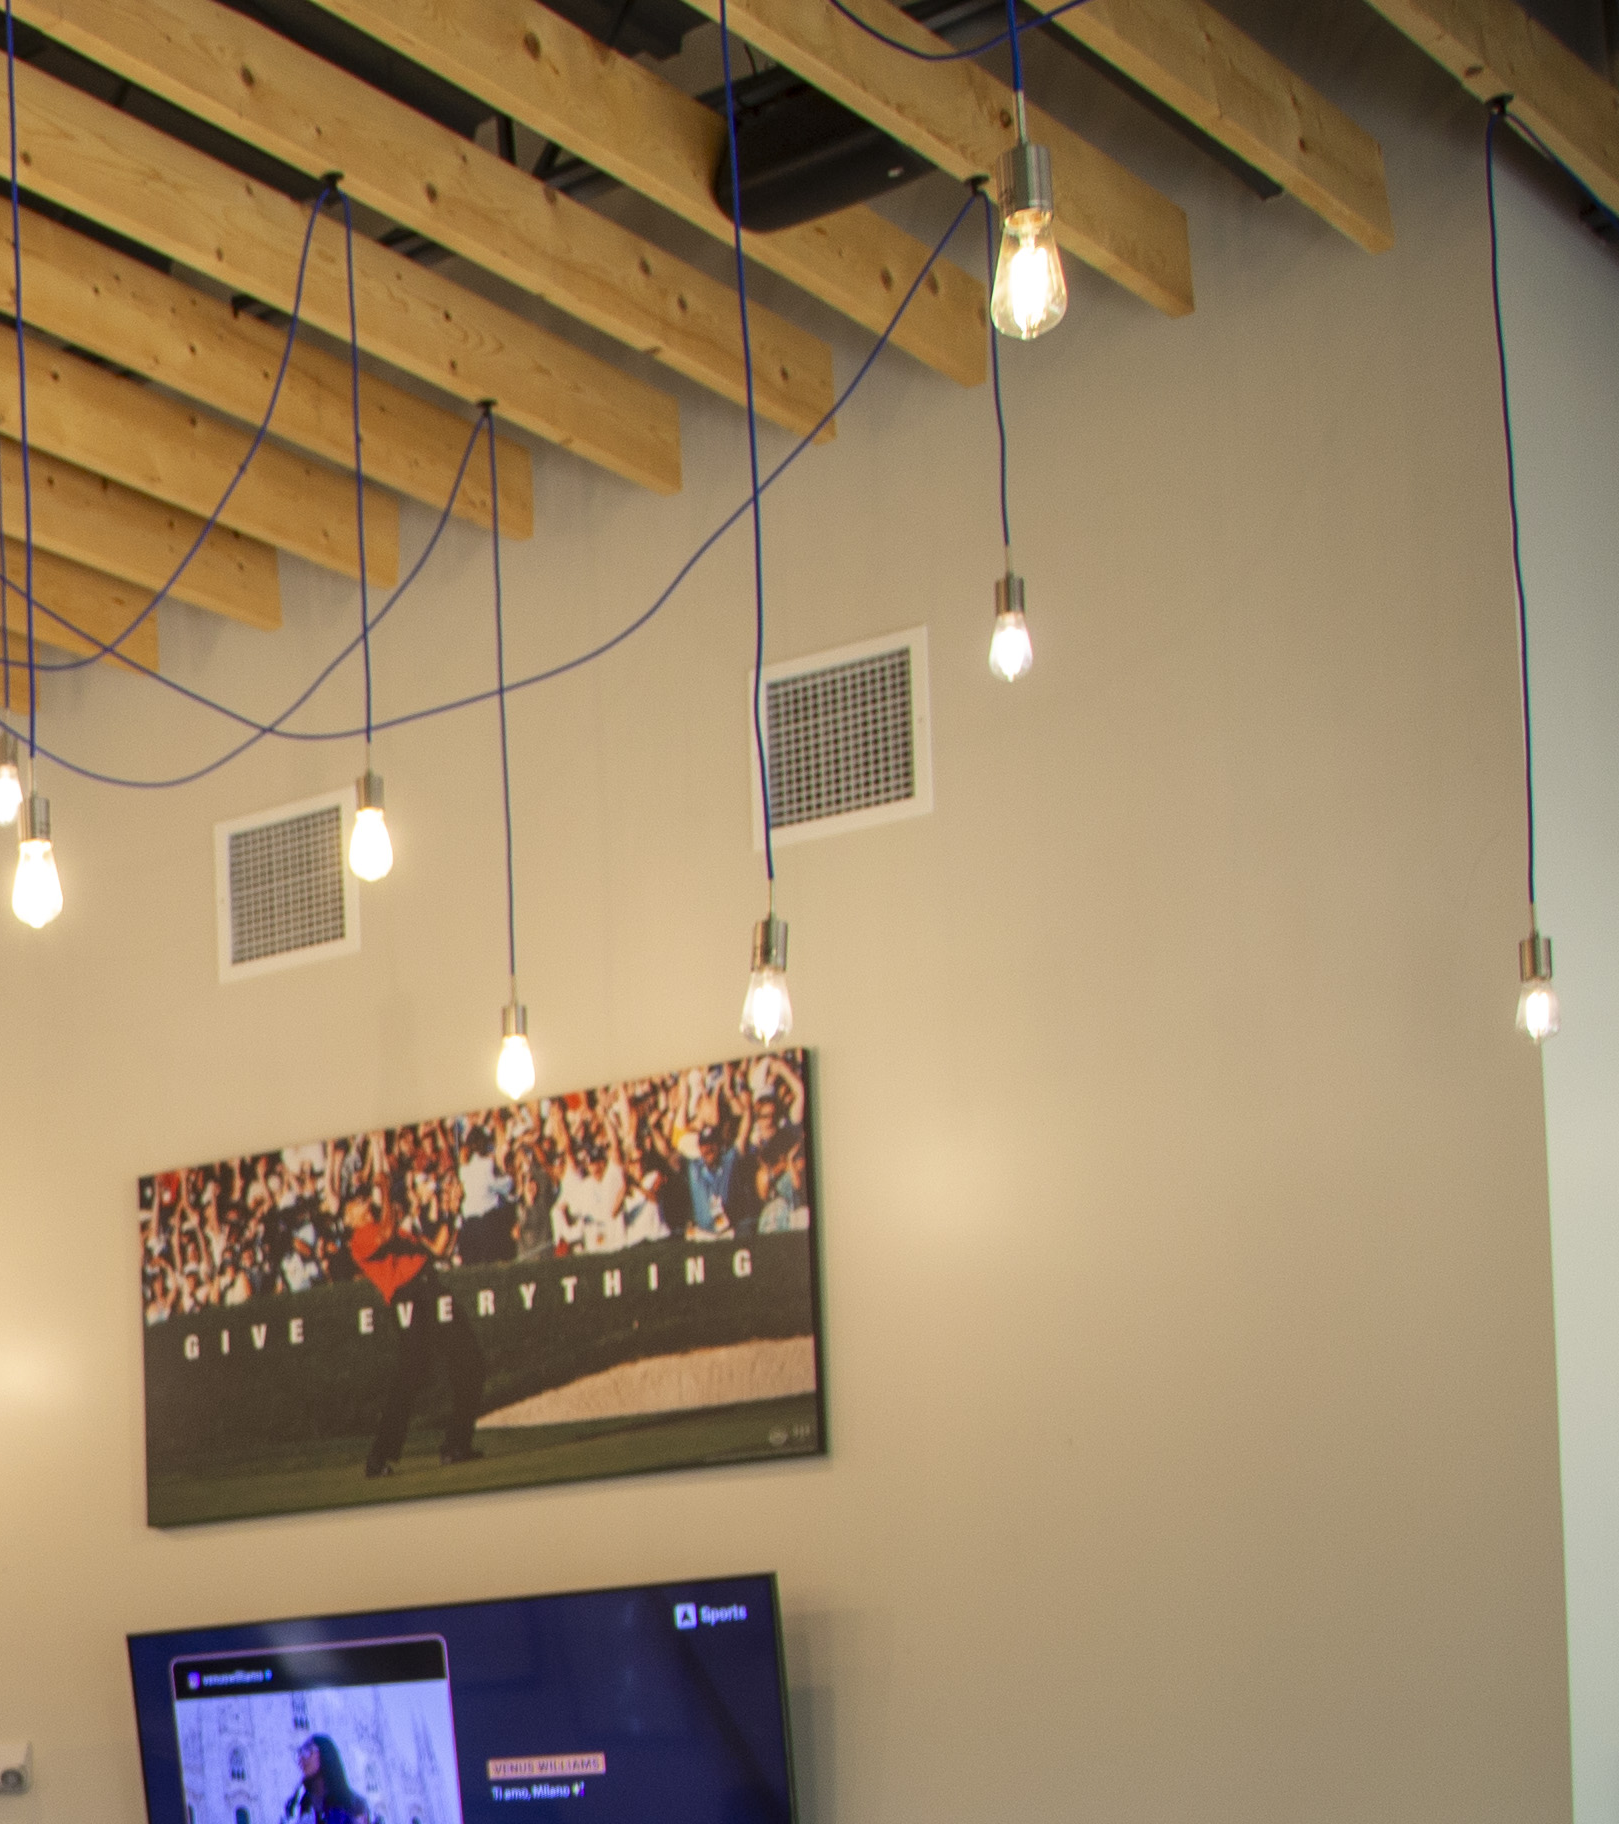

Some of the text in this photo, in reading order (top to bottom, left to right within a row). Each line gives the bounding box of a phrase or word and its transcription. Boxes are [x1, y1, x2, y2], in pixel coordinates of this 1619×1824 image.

[184, 1248, 756, 1362] GIVE EVERYTHING
[700, 1603, 749, 1627] Sports
